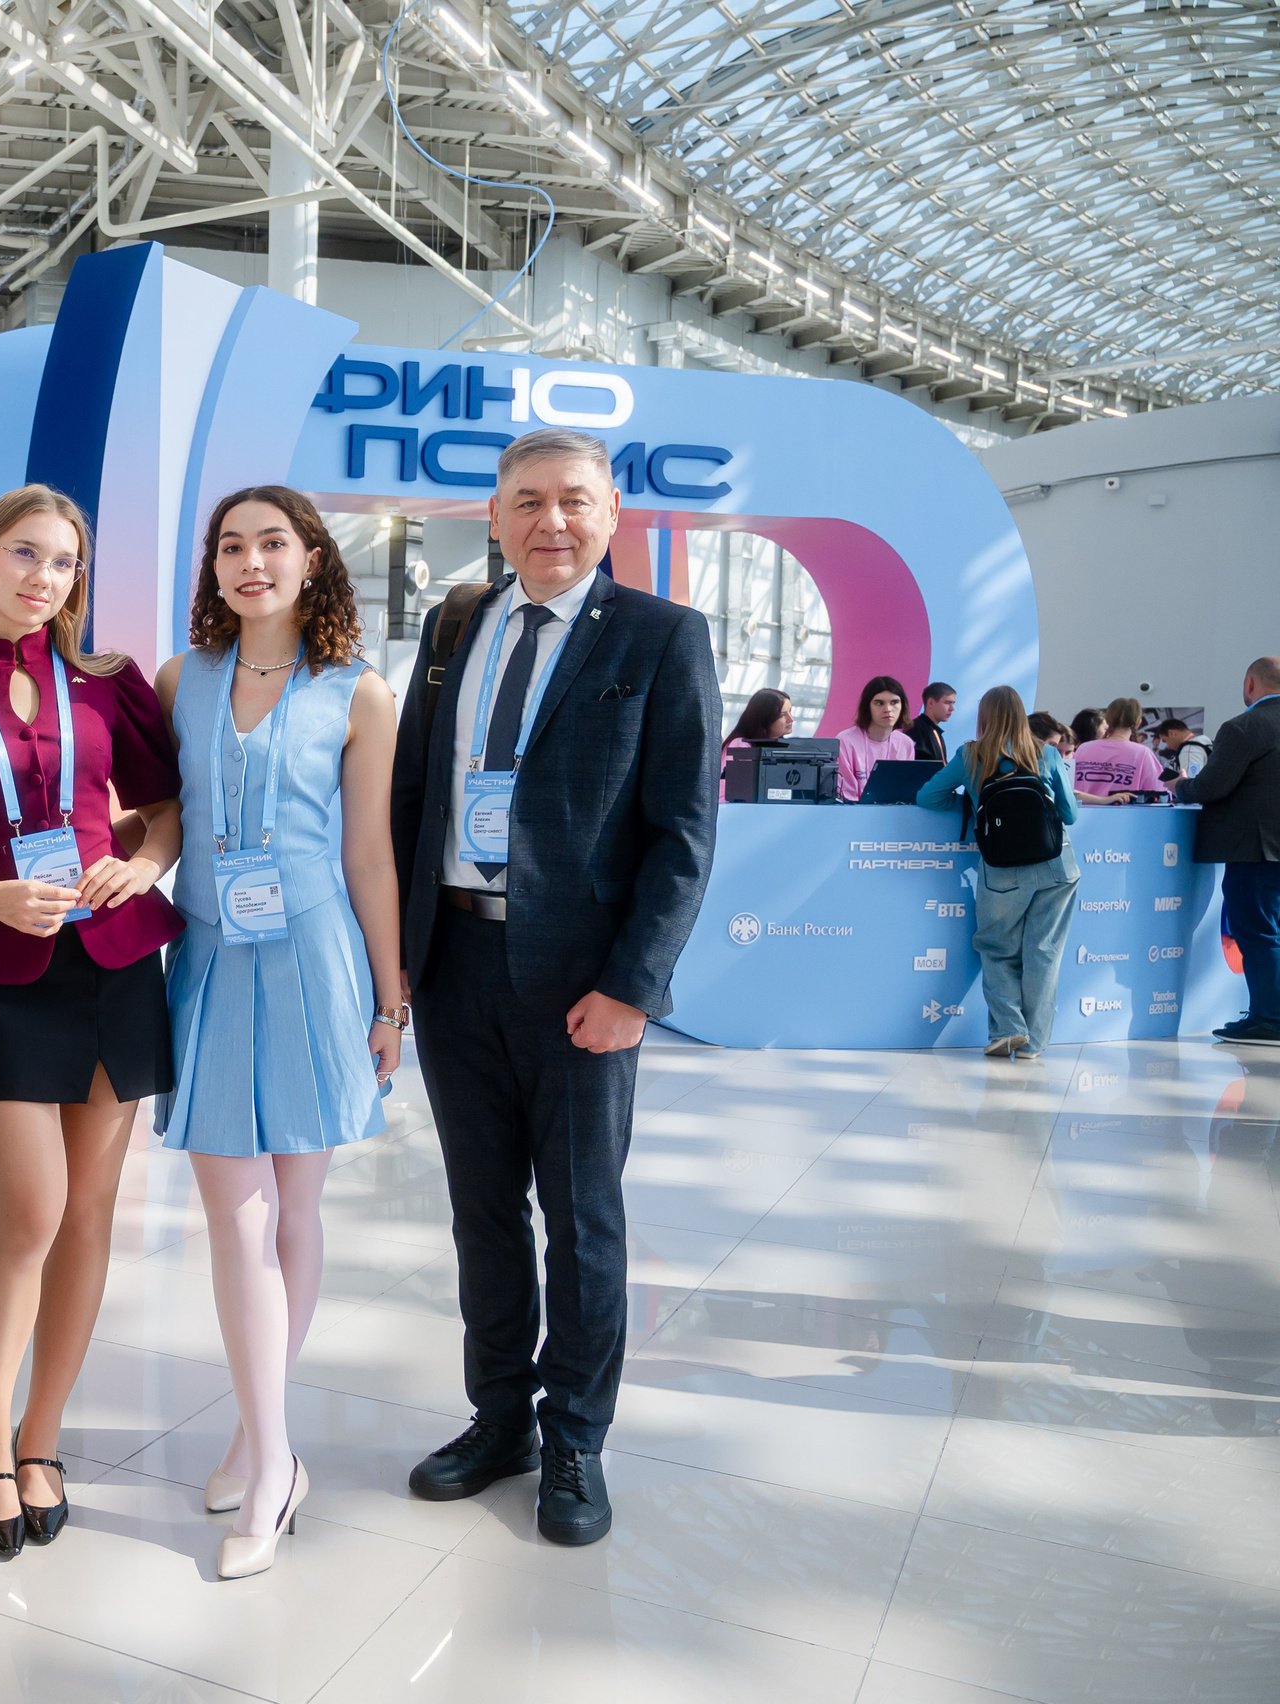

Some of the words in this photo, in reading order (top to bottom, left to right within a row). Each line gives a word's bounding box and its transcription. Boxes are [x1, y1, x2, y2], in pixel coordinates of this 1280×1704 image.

[311, 353, 635, 429] ФИНО
[347, 423, 734, 499] ПОИС
[786, 769, 801, 786] hp
[1076, 771, 1133, 785] 2025
[16, 834, 72, 851] УЧАСТНИК
[216, 854, 273, 868] УЧАСТНИК
[1084, 848, 1102, 864] wb
[1104, 848, 1131, 863] банк
[849, 860, 954, 870] ПАРТНЕРЫ
[937, 903, 966, 918] ВТБ
[1080, 898, 1131, 914] kaspersky
[1154, 896, 1182, 912] МИР
[767, 922, 800, 936] Банк
[804, 922, 853, 936] России
[1087, 952, 1130, 962] Ростелеком
[1160, 946, 1184, 959] СБЕР
[916, 959, 944, 968] MOEX
[1152, 990, 1177, 1002] Yandex
[1096, 1000, 1122, 1011] БАНК
[1148, 1004, 1163, 1015] B2B
[1163, 1002, 1178, 1013] Tech
